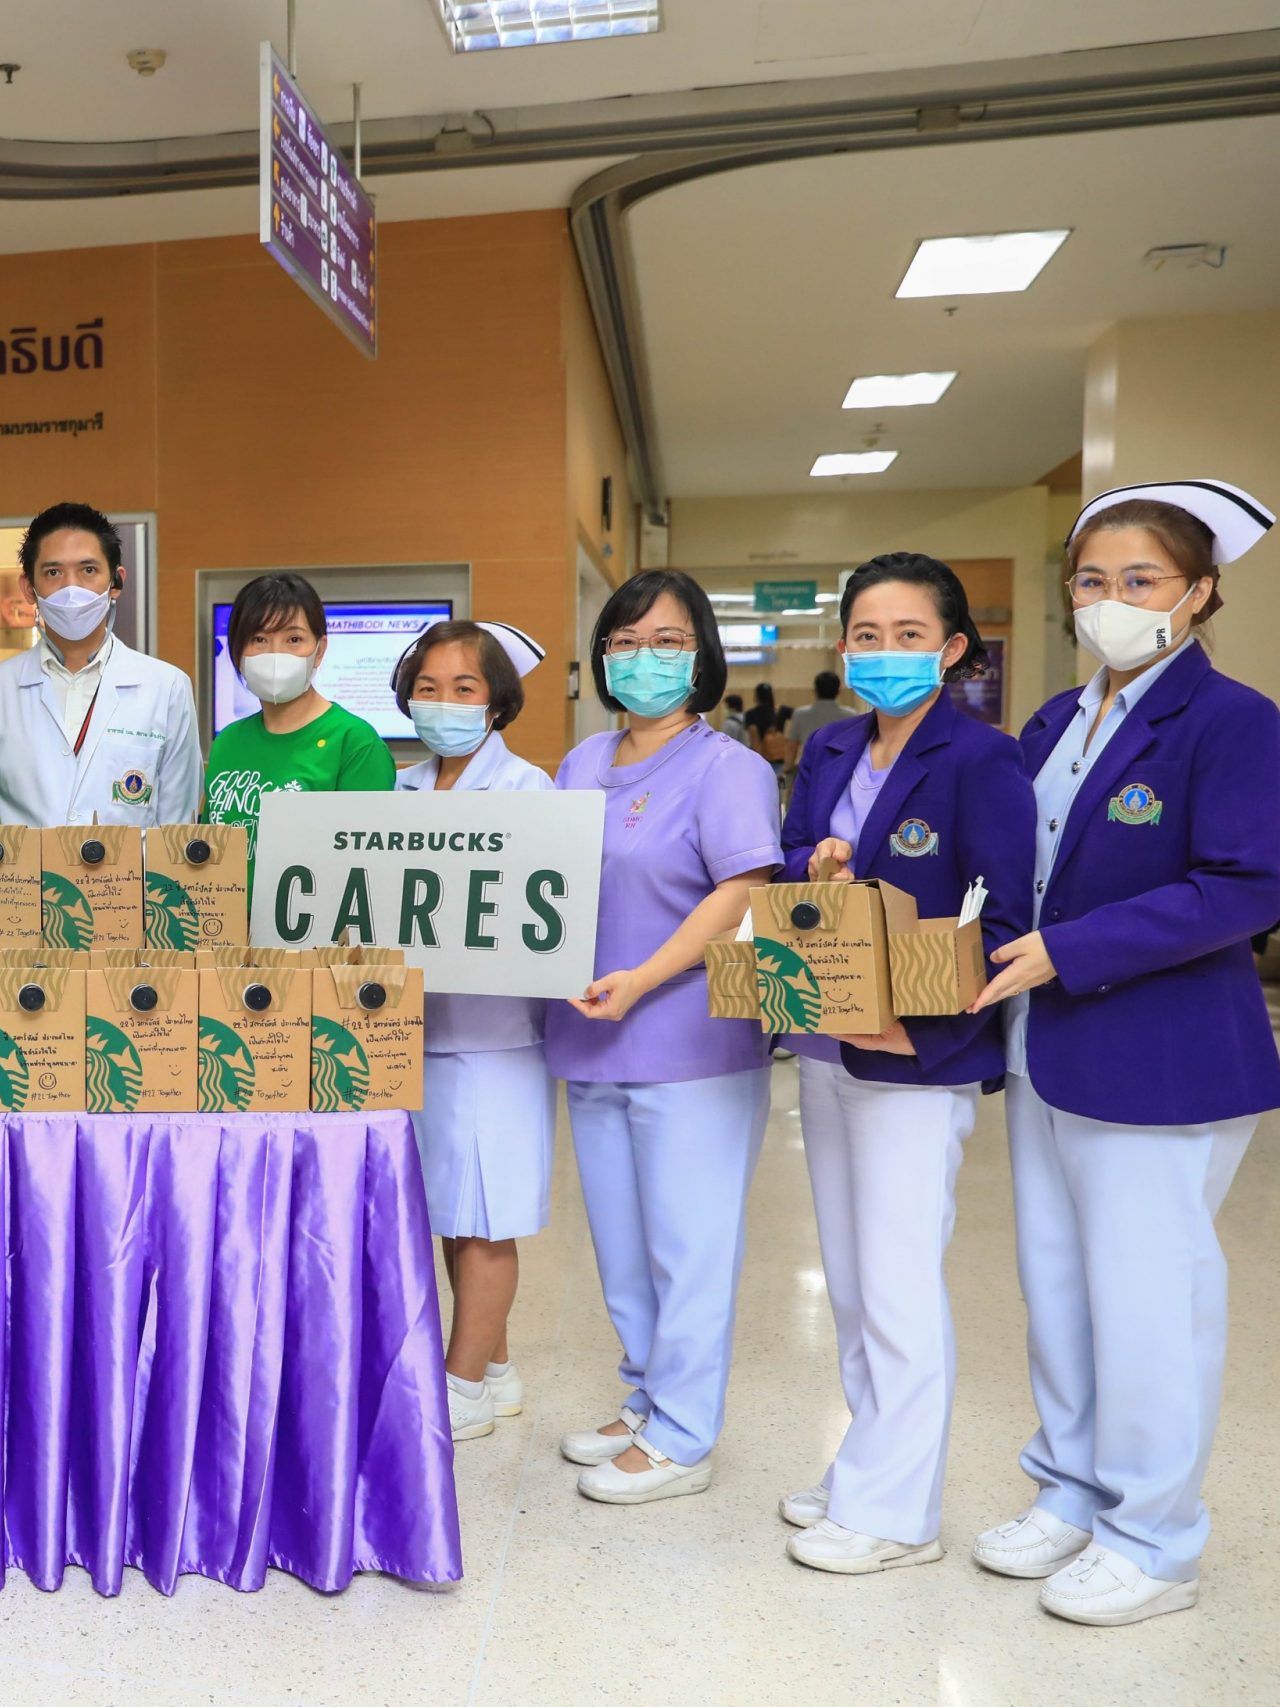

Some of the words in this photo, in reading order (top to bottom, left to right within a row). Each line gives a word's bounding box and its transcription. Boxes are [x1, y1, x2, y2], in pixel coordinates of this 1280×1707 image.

[387, 620, 418, 629] NEWS
[1156, 628, 1166, 649] SDPR
[209, 771, 260, 799] GOOD
[275, 865, 568, 954] CARES
[838, 1004, 864, 1015] Together
[159, 1088, 182, 1097] Together
[256, 1089, 288, 1100] Together
